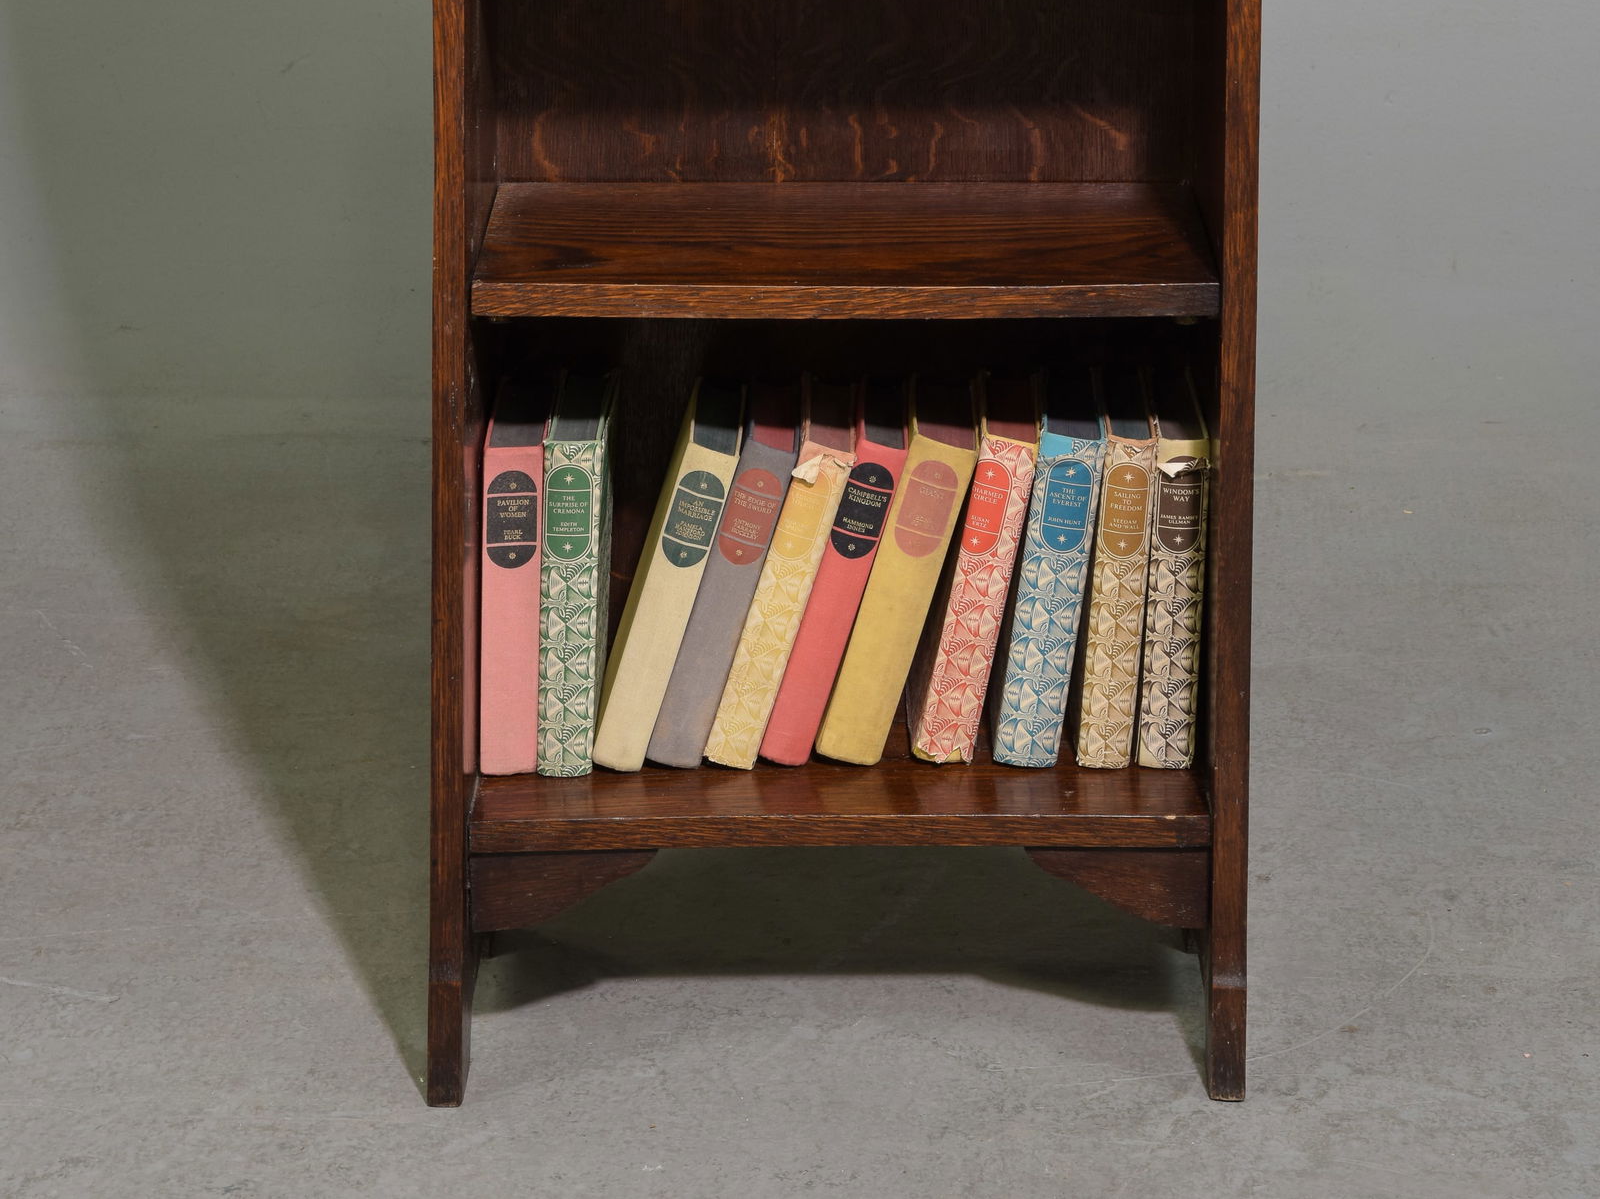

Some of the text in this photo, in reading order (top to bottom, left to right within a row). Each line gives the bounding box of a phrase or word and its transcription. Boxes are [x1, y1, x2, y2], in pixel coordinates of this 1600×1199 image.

[735, 491, 746, 499] THE
[748, 496, 766, 506] EDGE
[848, 487, 887, 503] CAMPBELL'S
[849, 494, 881, 508] KINGDOM
[974, 493, 997, 504] CIRCLE
[1050, 492, 1076, 500] ASCENT
[680, 500, 716, 515] IMPOSSIBLE
[735, 498, 772, 514] THE SWORD
[1053, 498, 1081, 507] EVEREST
[1110, 503, 1142, 511] FREEDOM
[678, 506, 712, 521] MARRIAGE
[971, 515, 990, 523] SUSAN
[843, 517, 874, 530] HAMMOND
[847, 524, 865, 533] INNES
